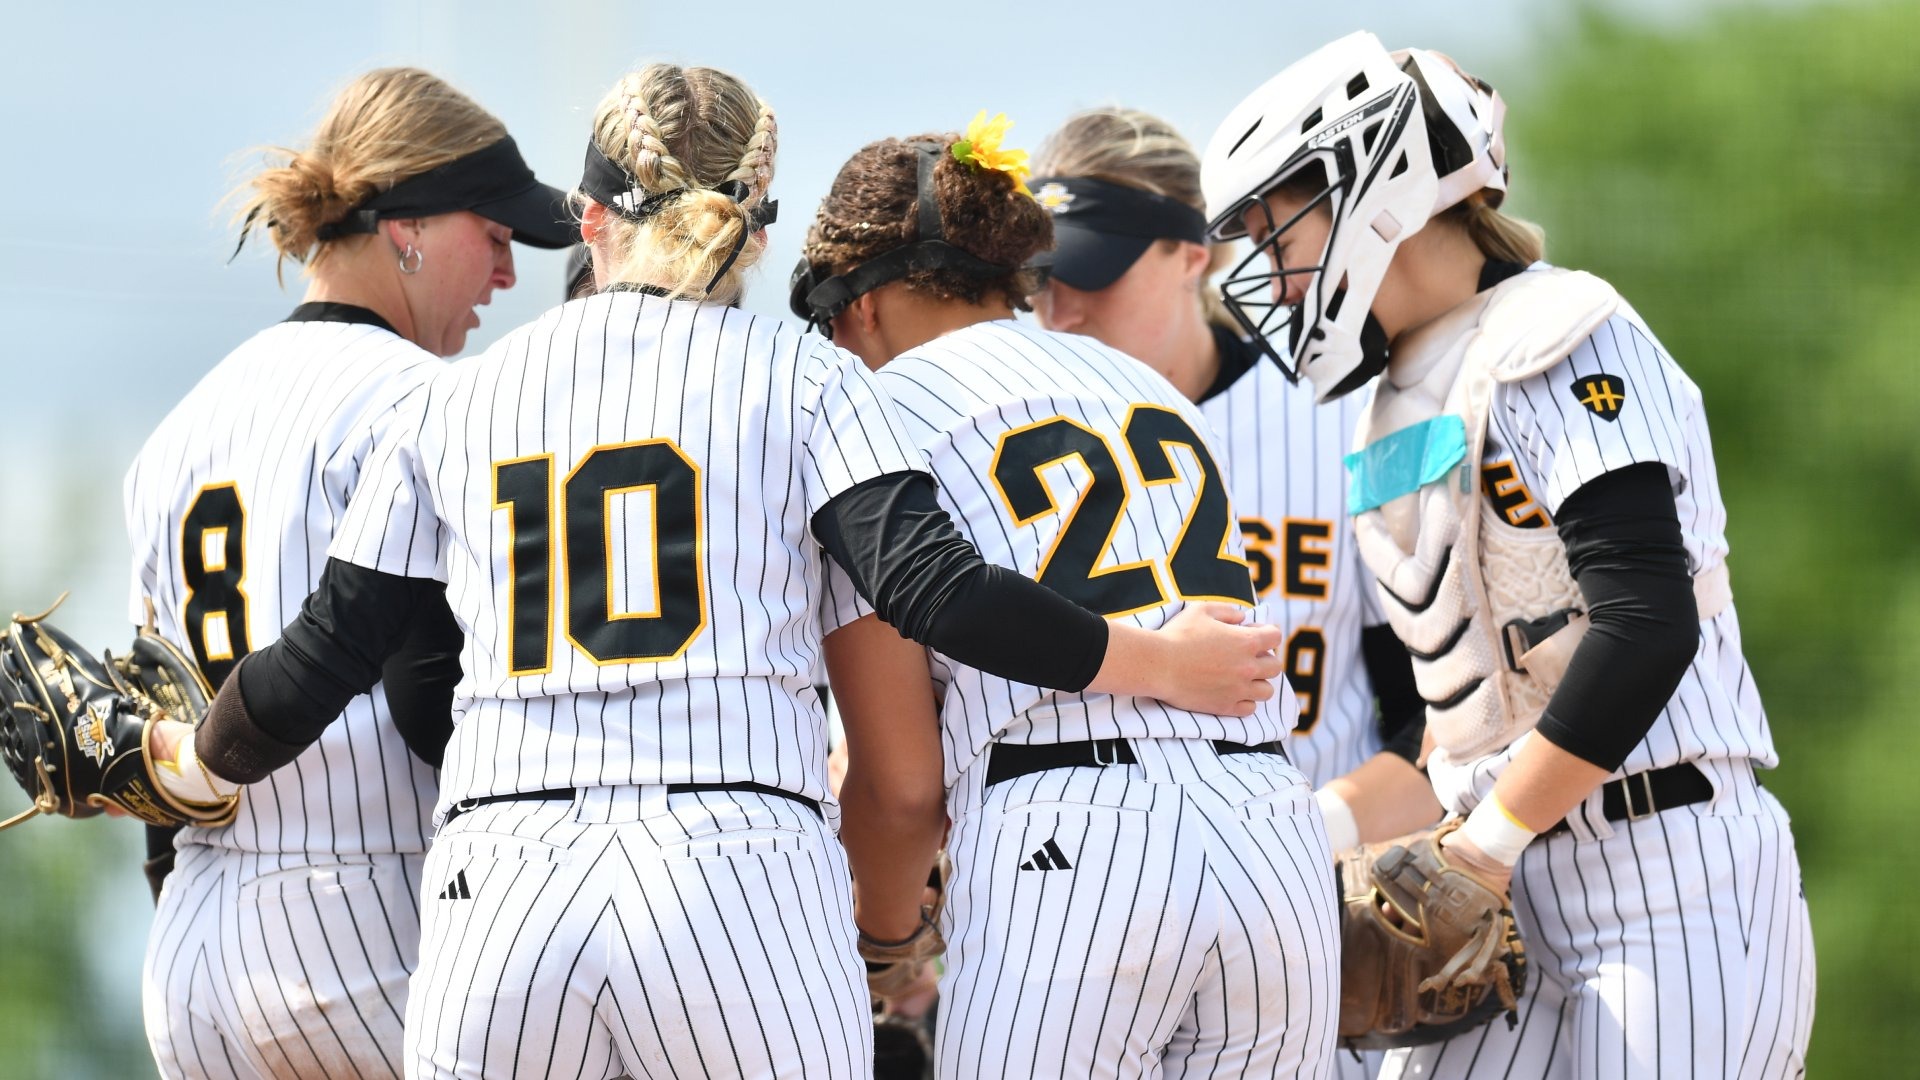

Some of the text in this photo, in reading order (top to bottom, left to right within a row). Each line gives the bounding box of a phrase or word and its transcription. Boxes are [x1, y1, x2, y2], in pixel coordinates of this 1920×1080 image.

[1307, 109, 1365, 150] EASTON
[181, 480, 252, 694] 8
[491, 437, 708, 678] 10
[988, 402, 1257, 619] 22
